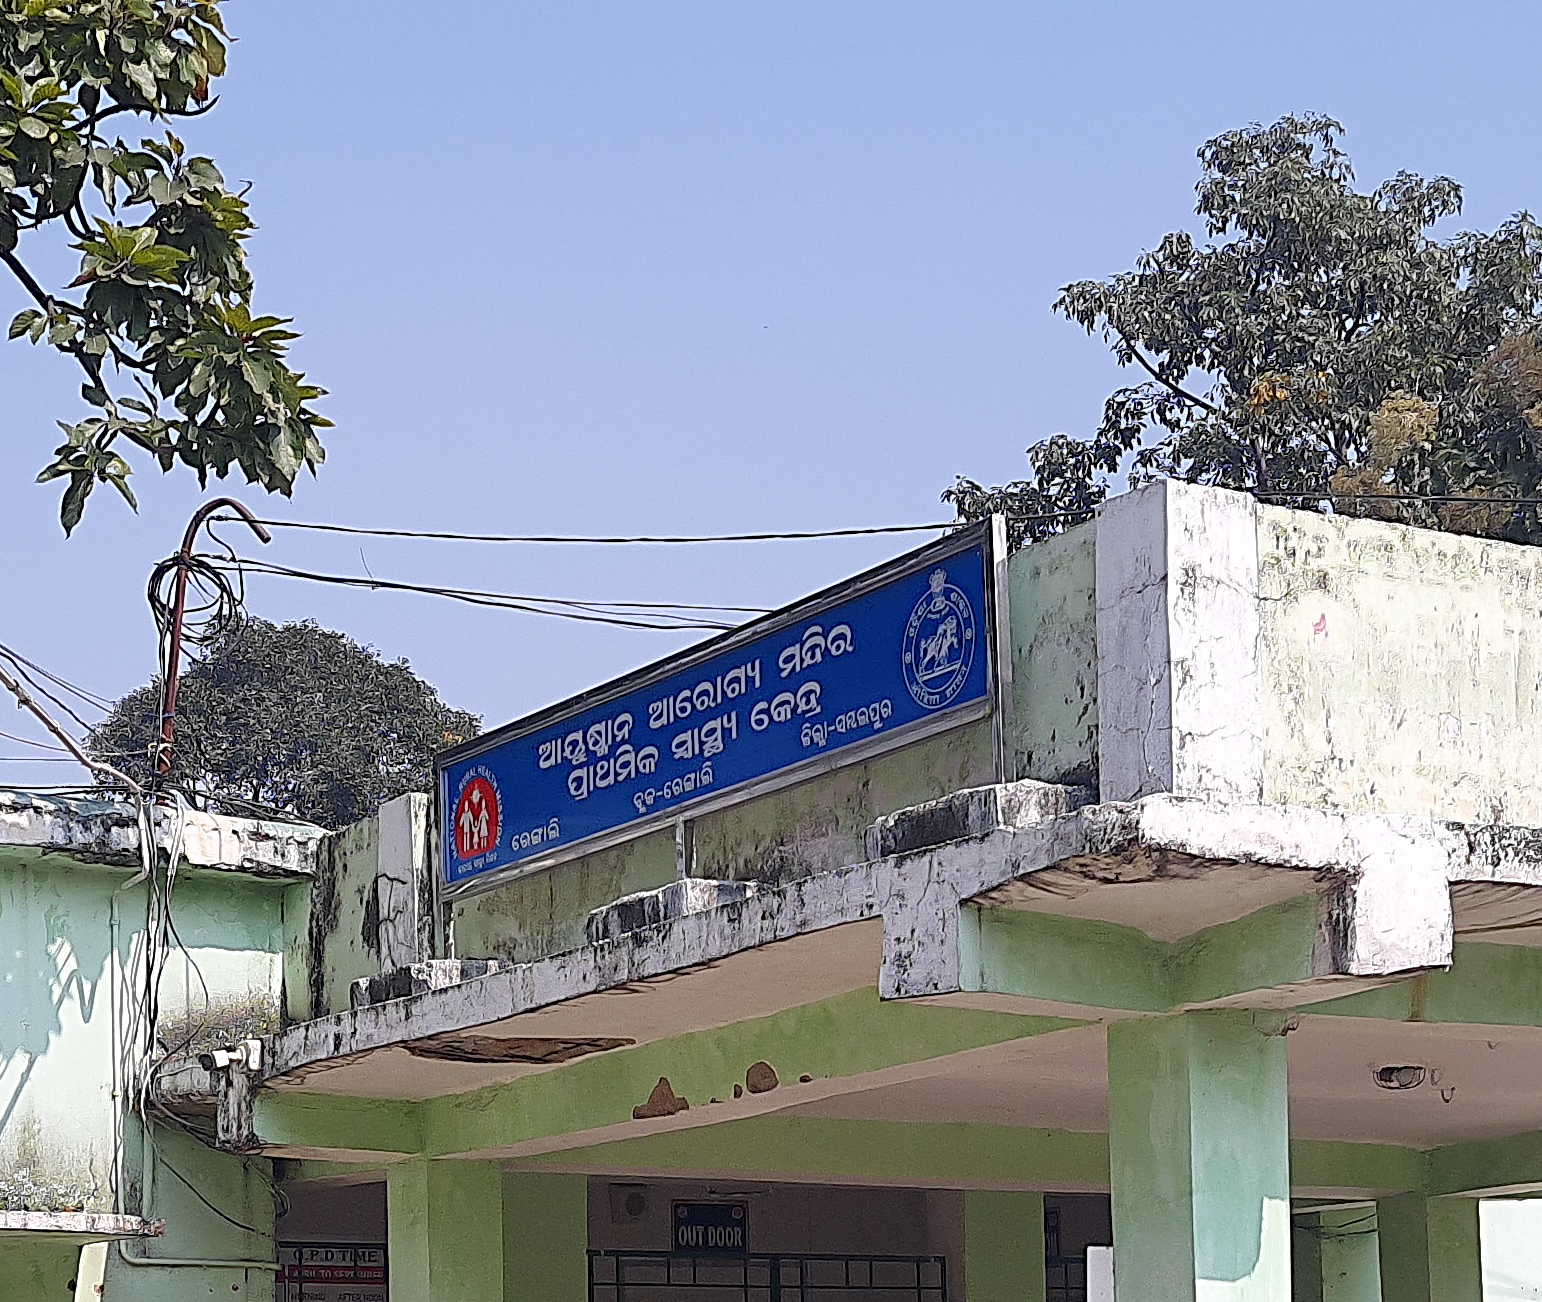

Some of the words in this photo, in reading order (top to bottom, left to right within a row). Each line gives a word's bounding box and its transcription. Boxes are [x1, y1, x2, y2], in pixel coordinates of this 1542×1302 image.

[648, 658, 761, 730] ଆରୋଗ୍ୟ
[778, 624, 855, 678] ମନ୍ଦିର
[568, 743, 659, 801] ପ୍ରାଥମିକ
[750, 680, 822, 731] କେନ୍ଦ୍ର
[679, 1225, 704, 1247] OUT
[708, 1225, 743, 1247] DOOR
